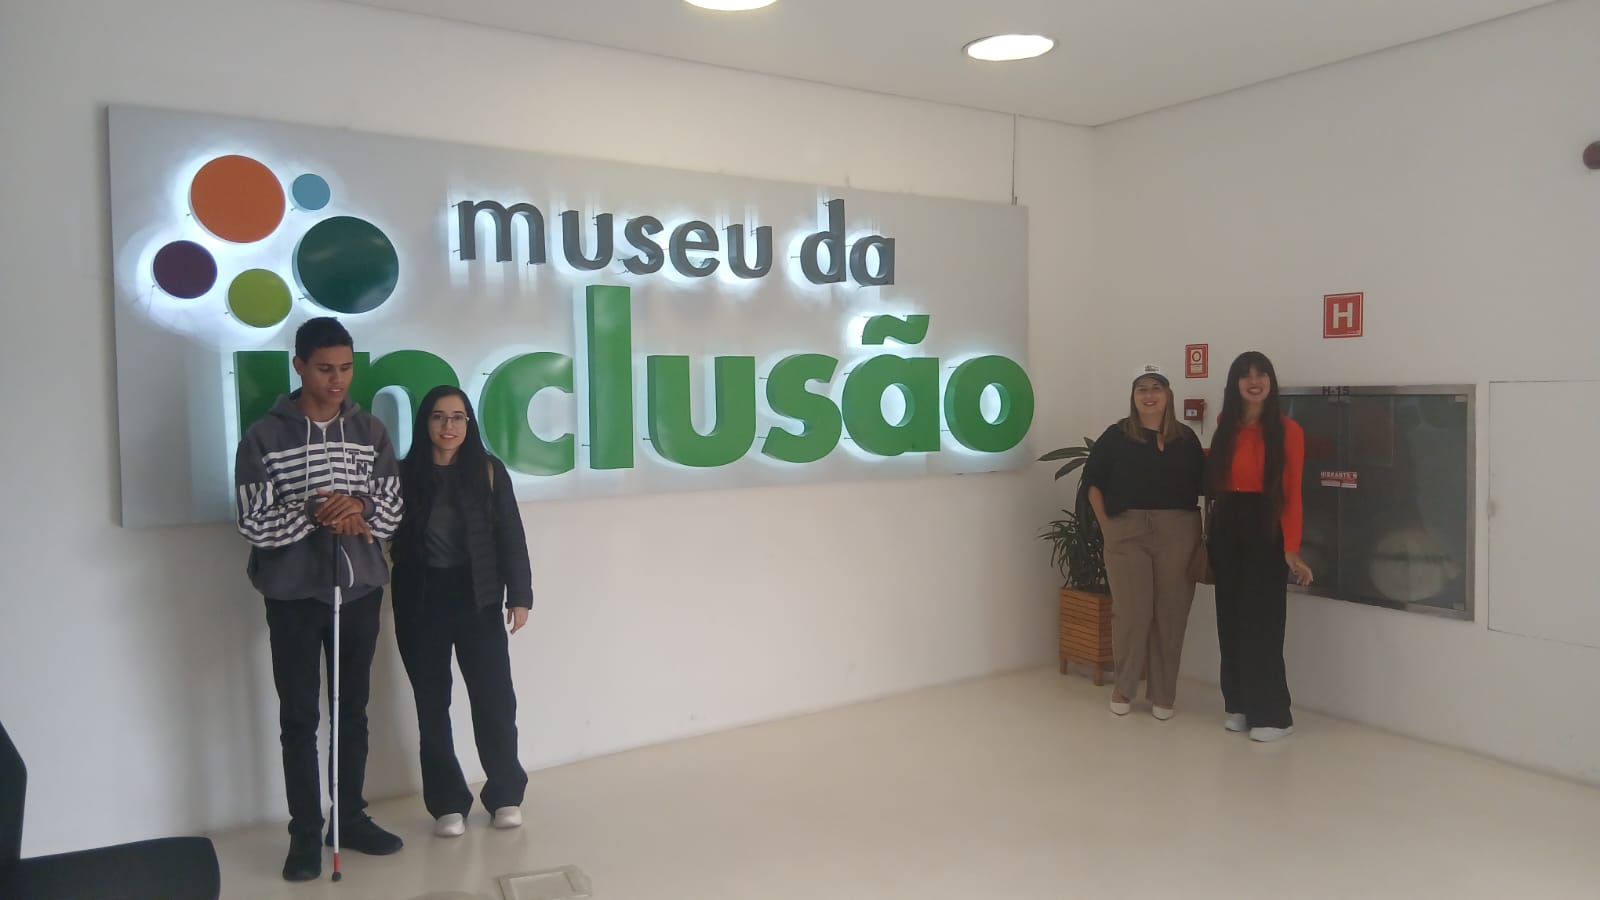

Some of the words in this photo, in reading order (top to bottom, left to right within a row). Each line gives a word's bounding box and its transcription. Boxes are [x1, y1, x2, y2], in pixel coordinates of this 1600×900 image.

[457, 199, 773, 279] museu
[800, 198, 895, 286] da
[1332, 302, 1353, 329] H
